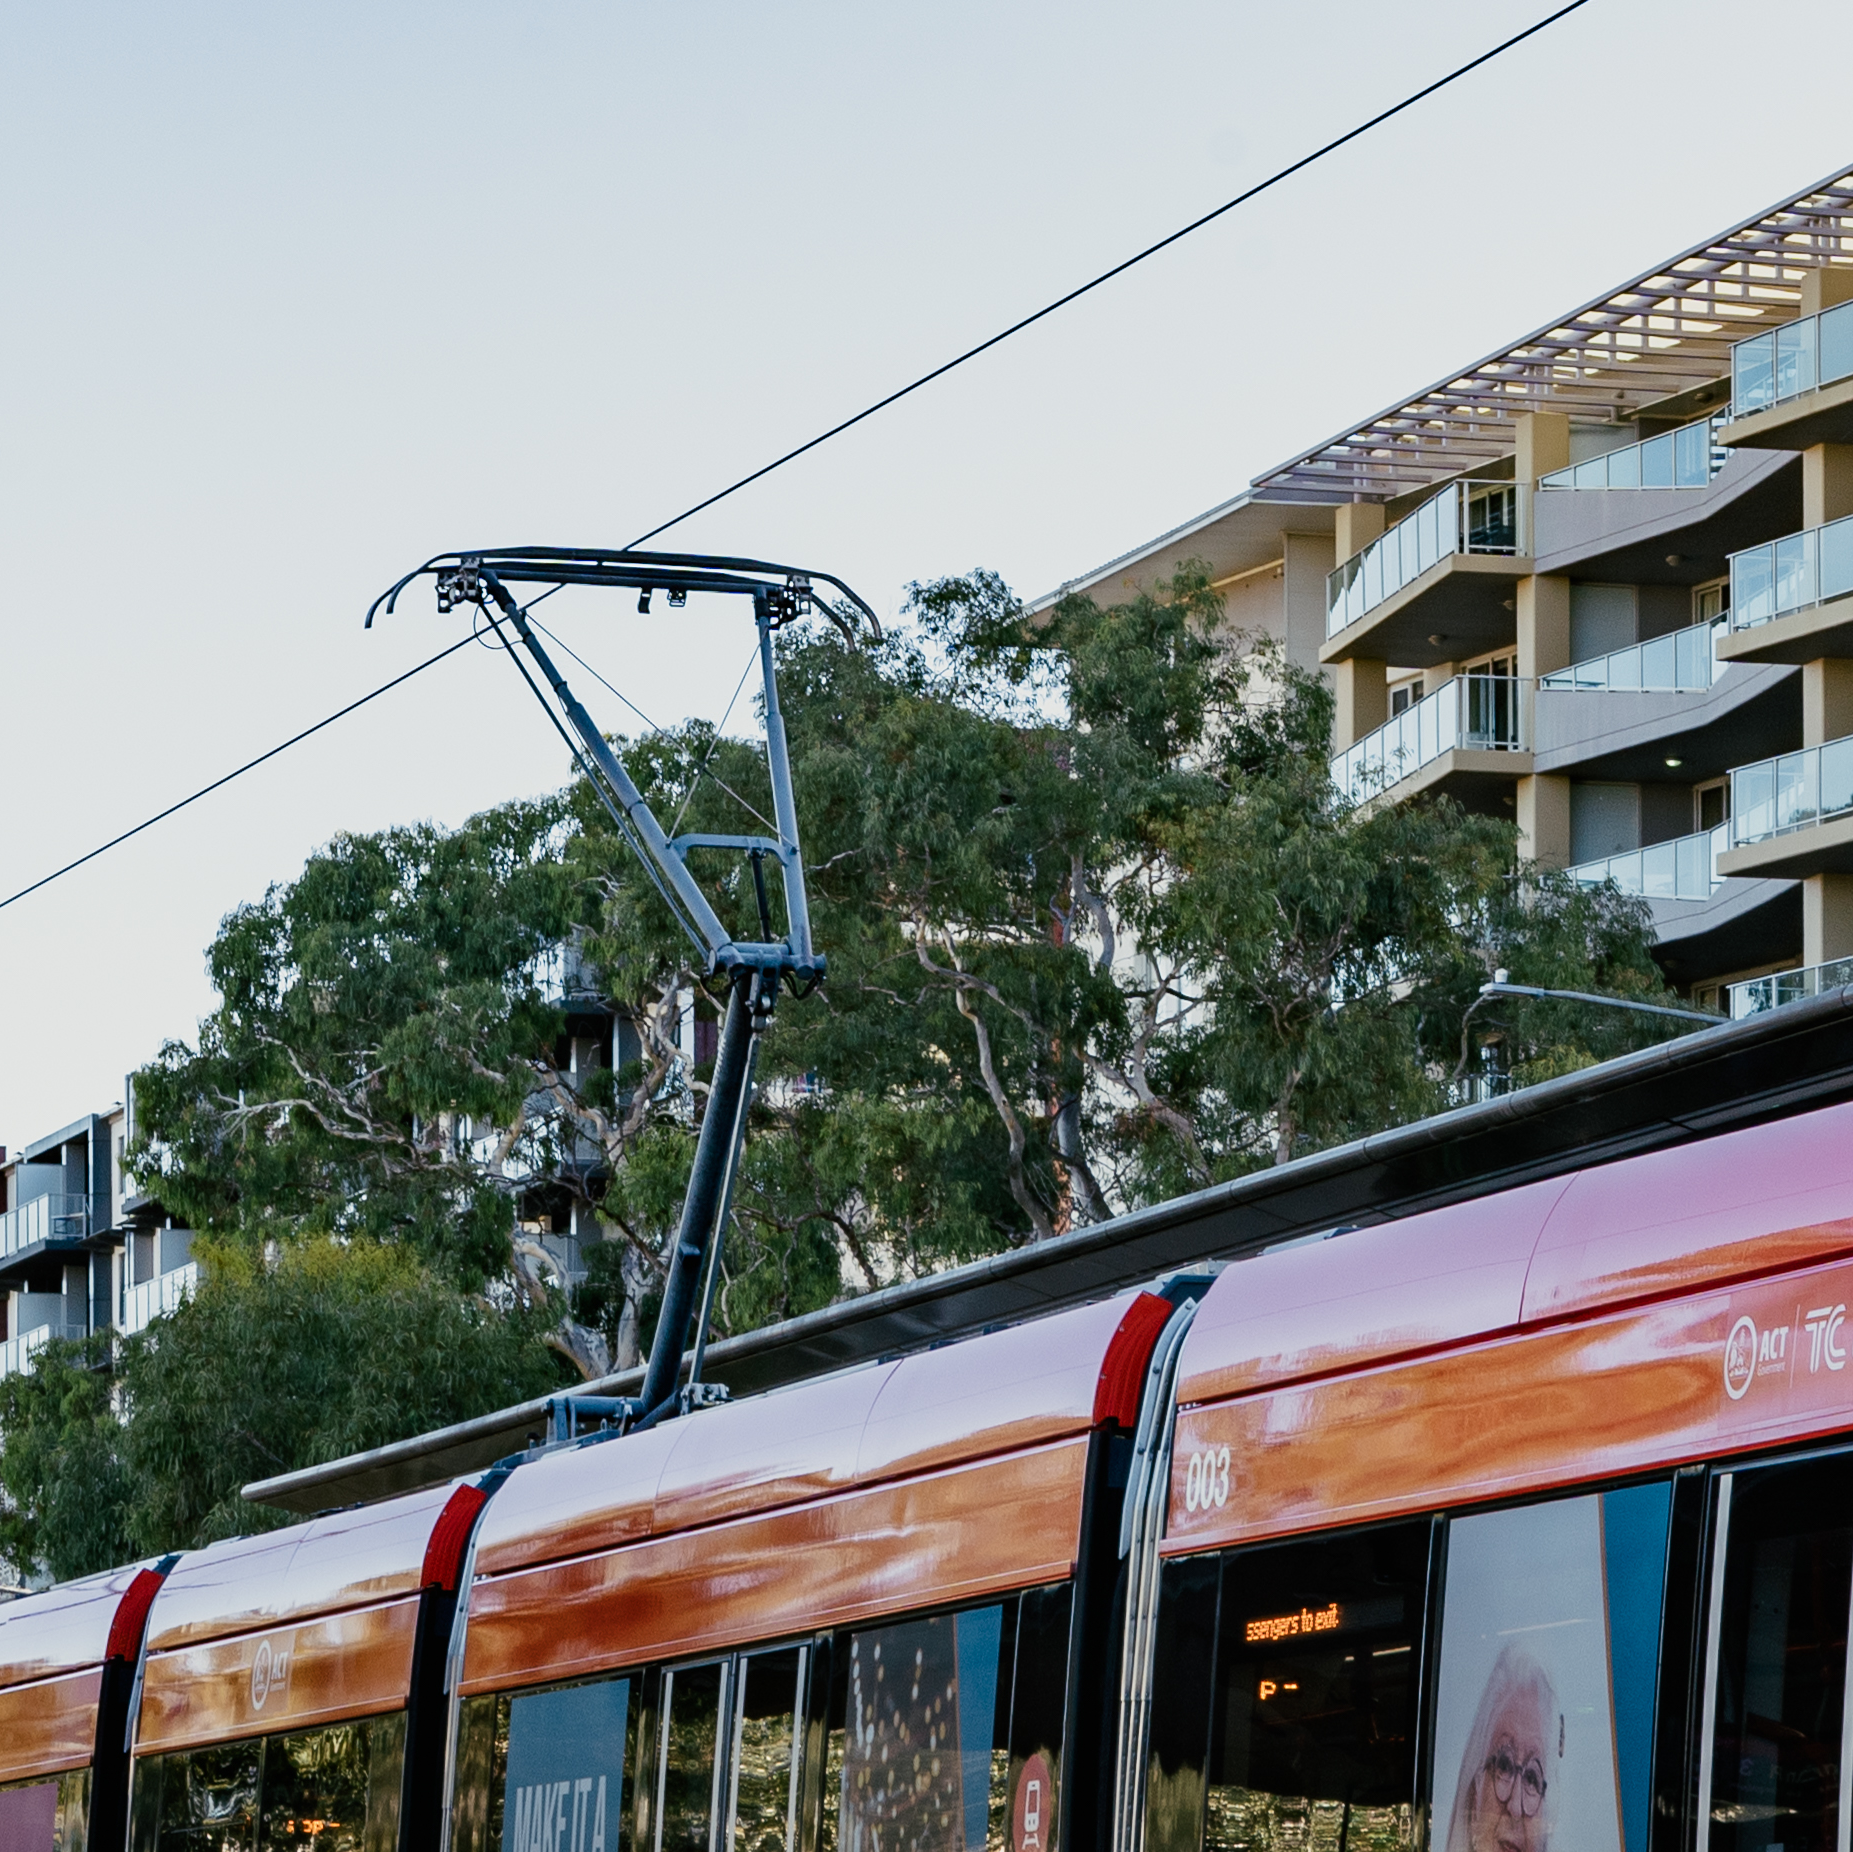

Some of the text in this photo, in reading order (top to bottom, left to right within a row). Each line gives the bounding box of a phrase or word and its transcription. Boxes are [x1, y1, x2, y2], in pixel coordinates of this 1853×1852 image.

[1759, 1326, 1789, 1362] ACT
[1805, 1304, 1846, 1375] TC
[1186, 1447, 1230, 1513] 003
[1301, 1607, 1313, 1633] to
[1315, 1603, 1339, 1631] exit
